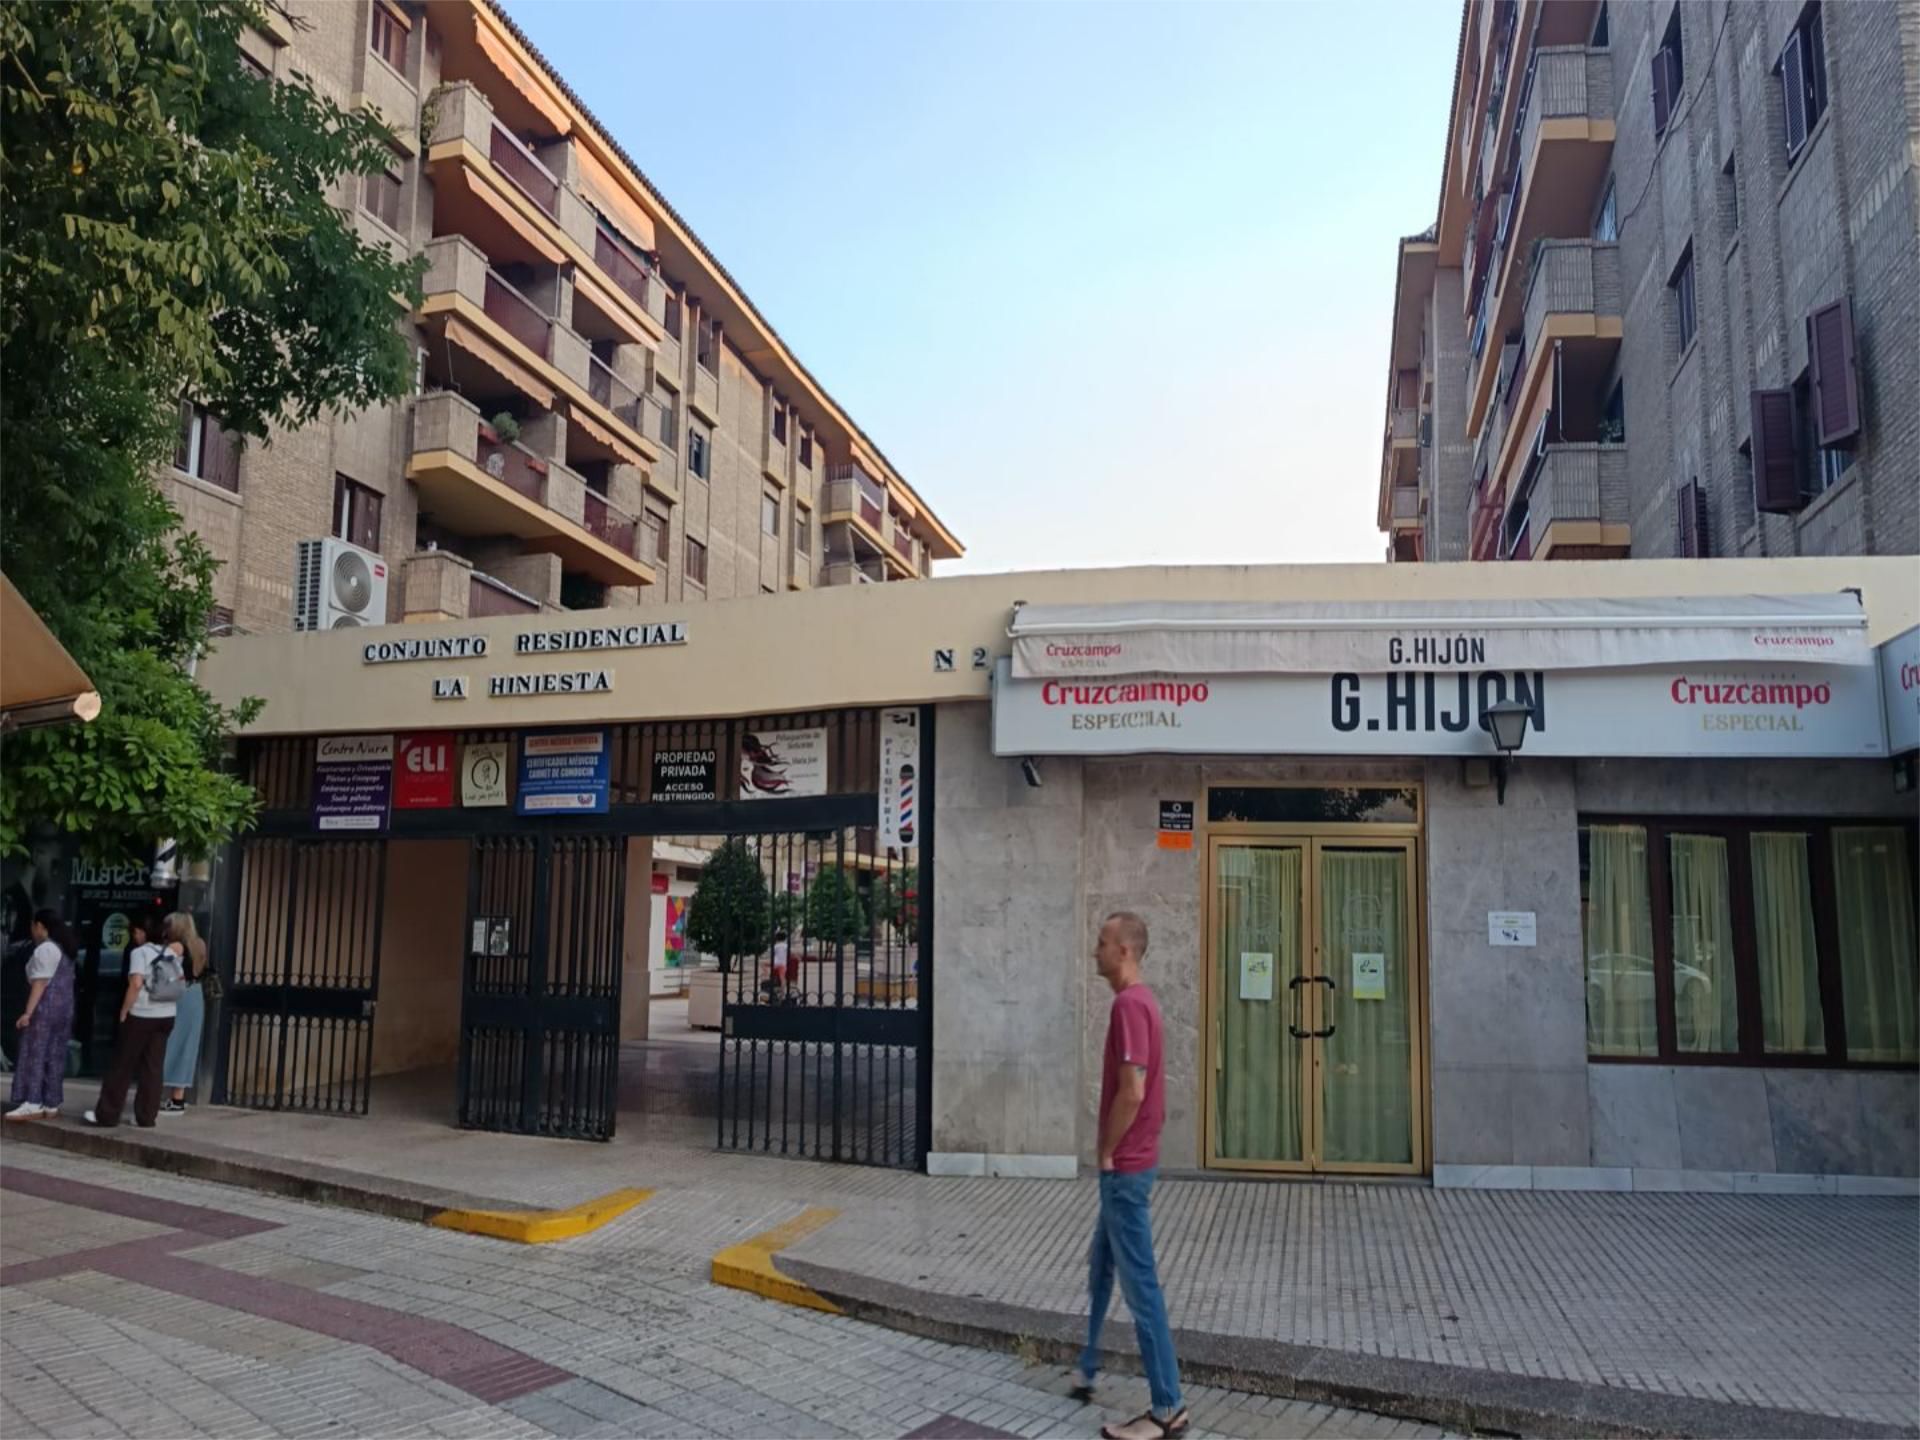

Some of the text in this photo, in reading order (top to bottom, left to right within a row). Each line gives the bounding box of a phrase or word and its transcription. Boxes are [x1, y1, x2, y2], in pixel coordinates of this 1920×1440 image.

[365, 624, 684, 661] CONJUNTO RESIDENCIAL
[1389, 633, 1485, 665] G.HIJÓN
[1754, 634, 1834, 649] Cruzcampo
[1046, 643, 1121, 657] Cruzcampo
[935, 647, 987, 669] N 2
[435, 671, 609, 697] LA HINIESTA
[1671, 676, 1831, 709] Cruzcampo
[1703, 713, 1804, 731] ESPECIAL
[321, 741, 354, 755] Centro
[406, 745, 446, 773] ELI
[526, 756, 568, 769] CERTIFICADOS
[654, 751, 716, 763] PROPIEDAD
[528, 767, 594, 779] CARNET DE CONDUCIR
[661, 765, 707, 777] PRIVADA
[665, 782, 704, 791] ACCESO
[652, 792, 715, 801] RESTRINGIDO
[70, 857, 150, 886] Mister
